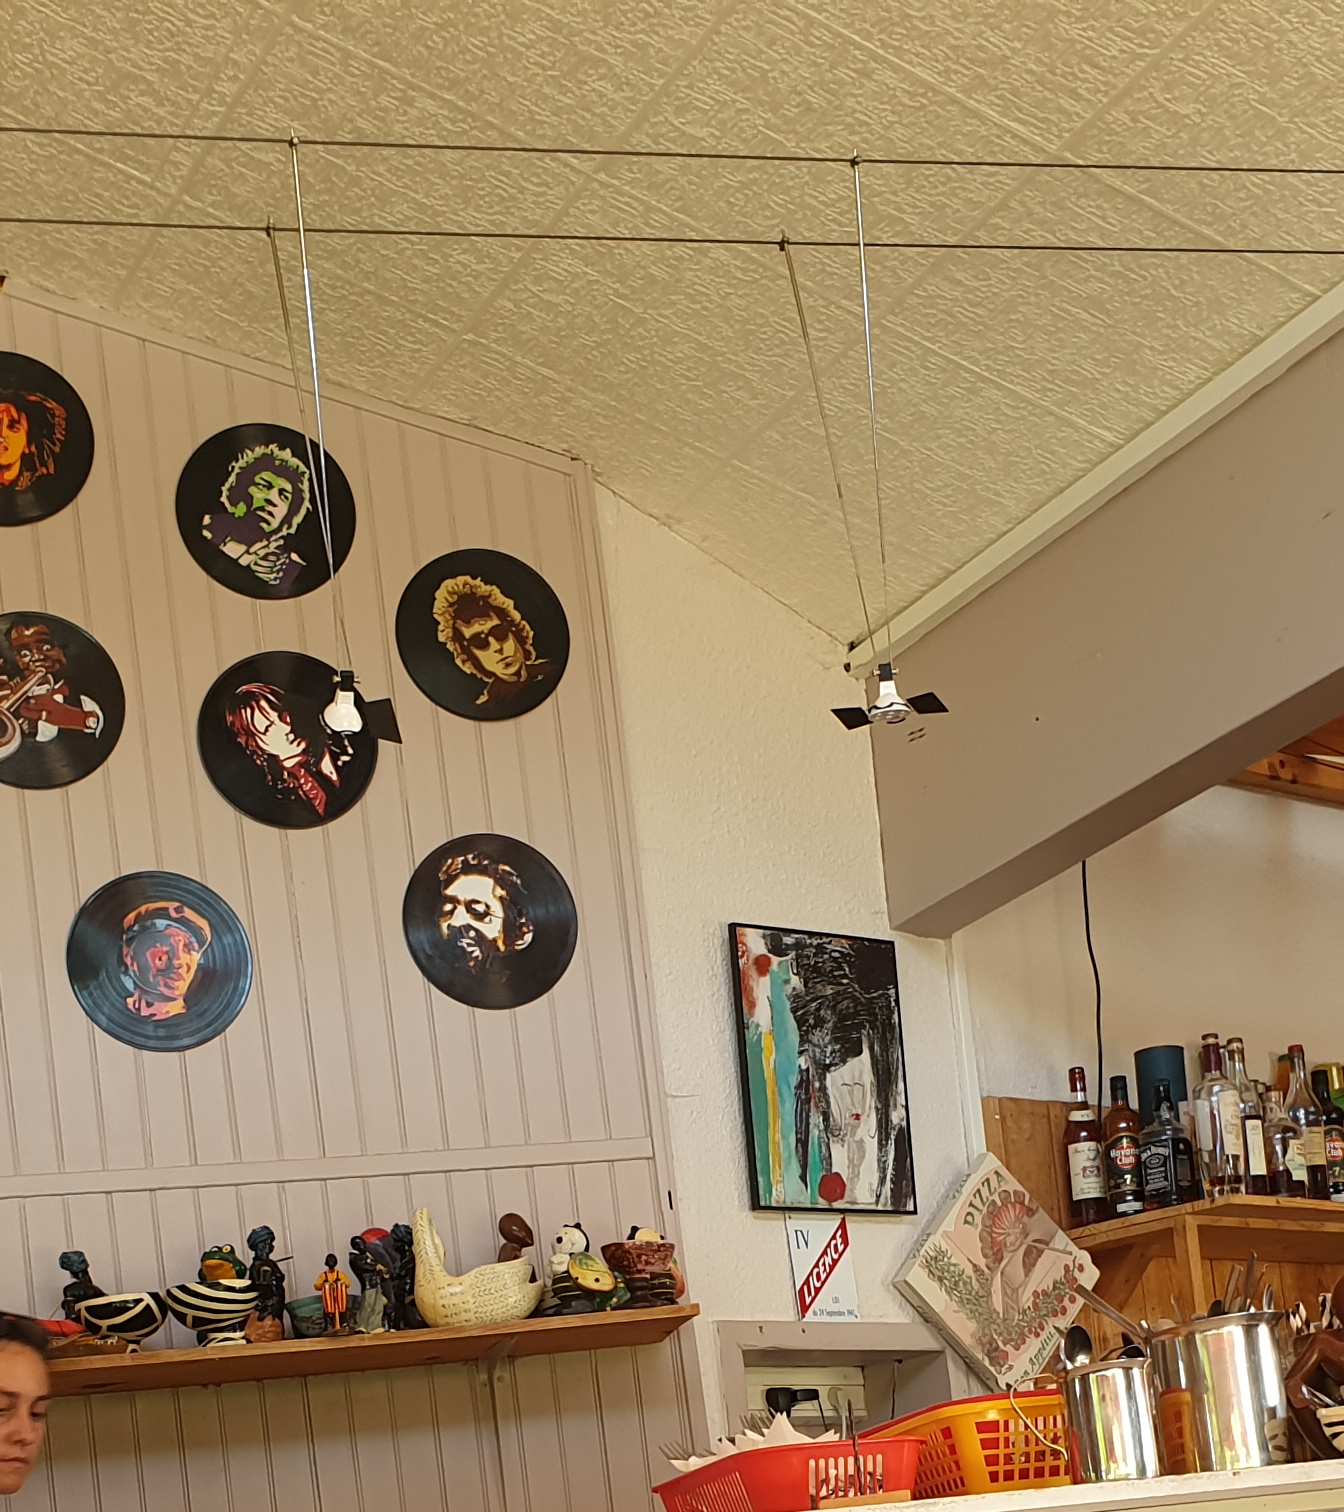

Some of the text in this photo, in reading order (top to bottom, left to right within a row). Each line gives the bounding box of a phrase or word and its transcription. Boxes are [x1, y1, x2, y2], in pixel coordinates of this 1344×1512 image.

[1116, 1155, 1135, 1165] Club
[1123, 1174, 1132, 1185] 7
[962, 1169, 1009, 1231] PIZZA
[794, 1229, 810, 1250] IV
[802, 1228, 845, 1306] LICENCE
